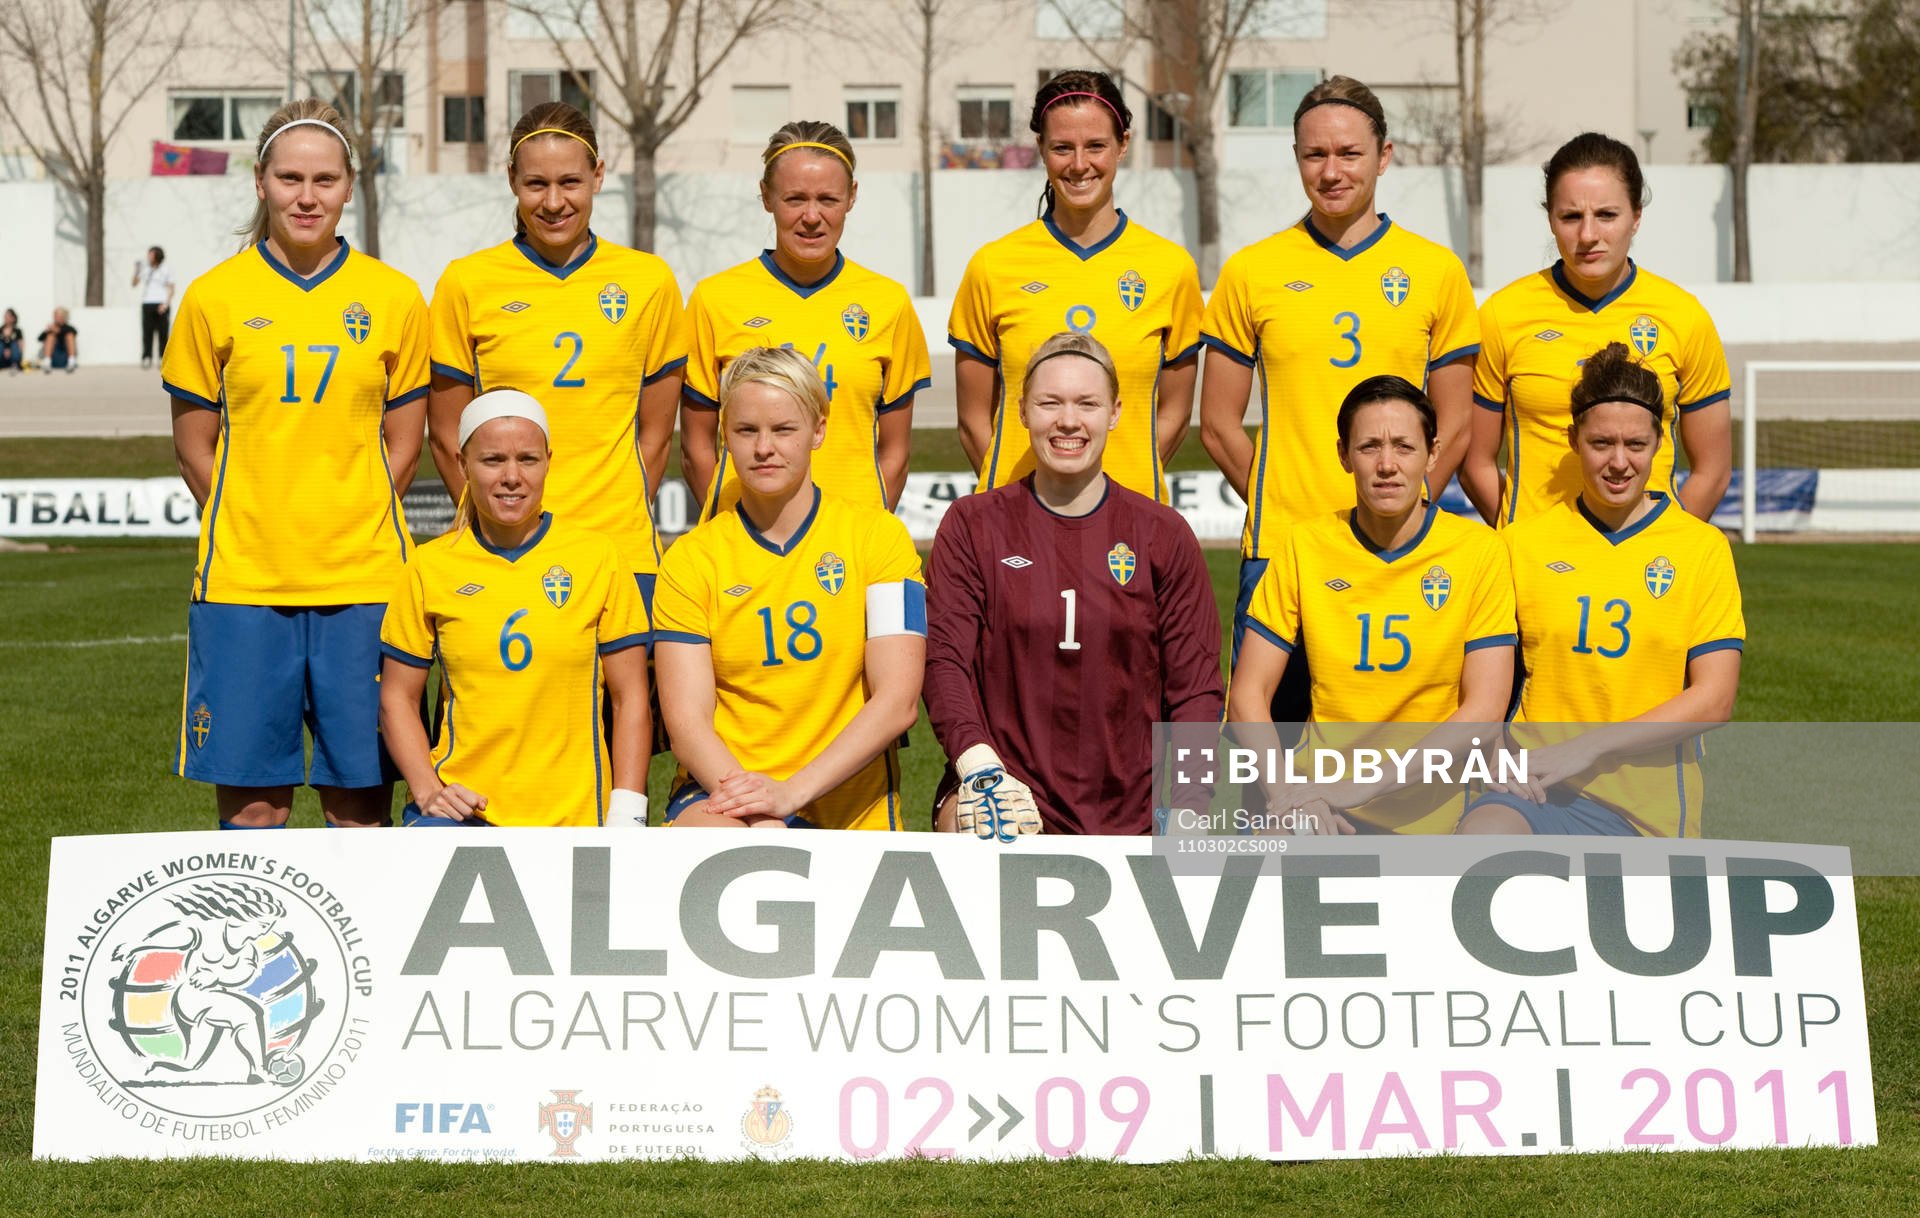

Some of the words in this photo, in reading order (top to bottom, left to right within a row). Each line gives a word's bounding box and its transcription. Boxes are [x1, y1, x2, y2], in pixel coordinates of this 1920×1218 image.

[552, 332, 586, 387] 2
[1330, 311, 1362, 369] 3
[280, 345, 340, 403] 17
[499, 609, 533, 672] 6
[757, 600, 823, 667] 18
[1058, 589, 1081, 650] 1
[1353, 613, 1411, 673] 15
[1571, 596, 1632, 658] 13
[60, 954, 85, 1000] 2011
[77, 871, 158, 949] ALGARVE
[280, 866, 363, 951] FOOTBALL
[352, 955, 372, 997] CUP
[400, 846, 1387, 981] ALGARVE
[1451, 850, 1835, 977] CUP
[402, 990, 769, 1052] ALGARVE
[1236, 990, 1651, 1051] FOOTBALL
[1680, 990, 1841, 1048] CUP
[62, 1022, 138, 1119] MUNDIALITO
[140, 1111, 168, 1134] DE
[172, 1120, 260, 1141] FUTEBOL
[265, 1064, 345, 1130] FEMININO
[339, 1017, 370, 1062] 2011
[609, 1102, 703, 1115] FEDERAÇÃO
[395, 1103, 491, 1133] FIFA
[609, 1124, 715, 1133] PORTUGUESA
[1267, 1071, 1537, 1152] MAR.
[1621, 1069, 1852, 1146] 2011
[609, 1145, 628, 1154] DE
[635, 1145, 705, 1154] FUTEBOL
